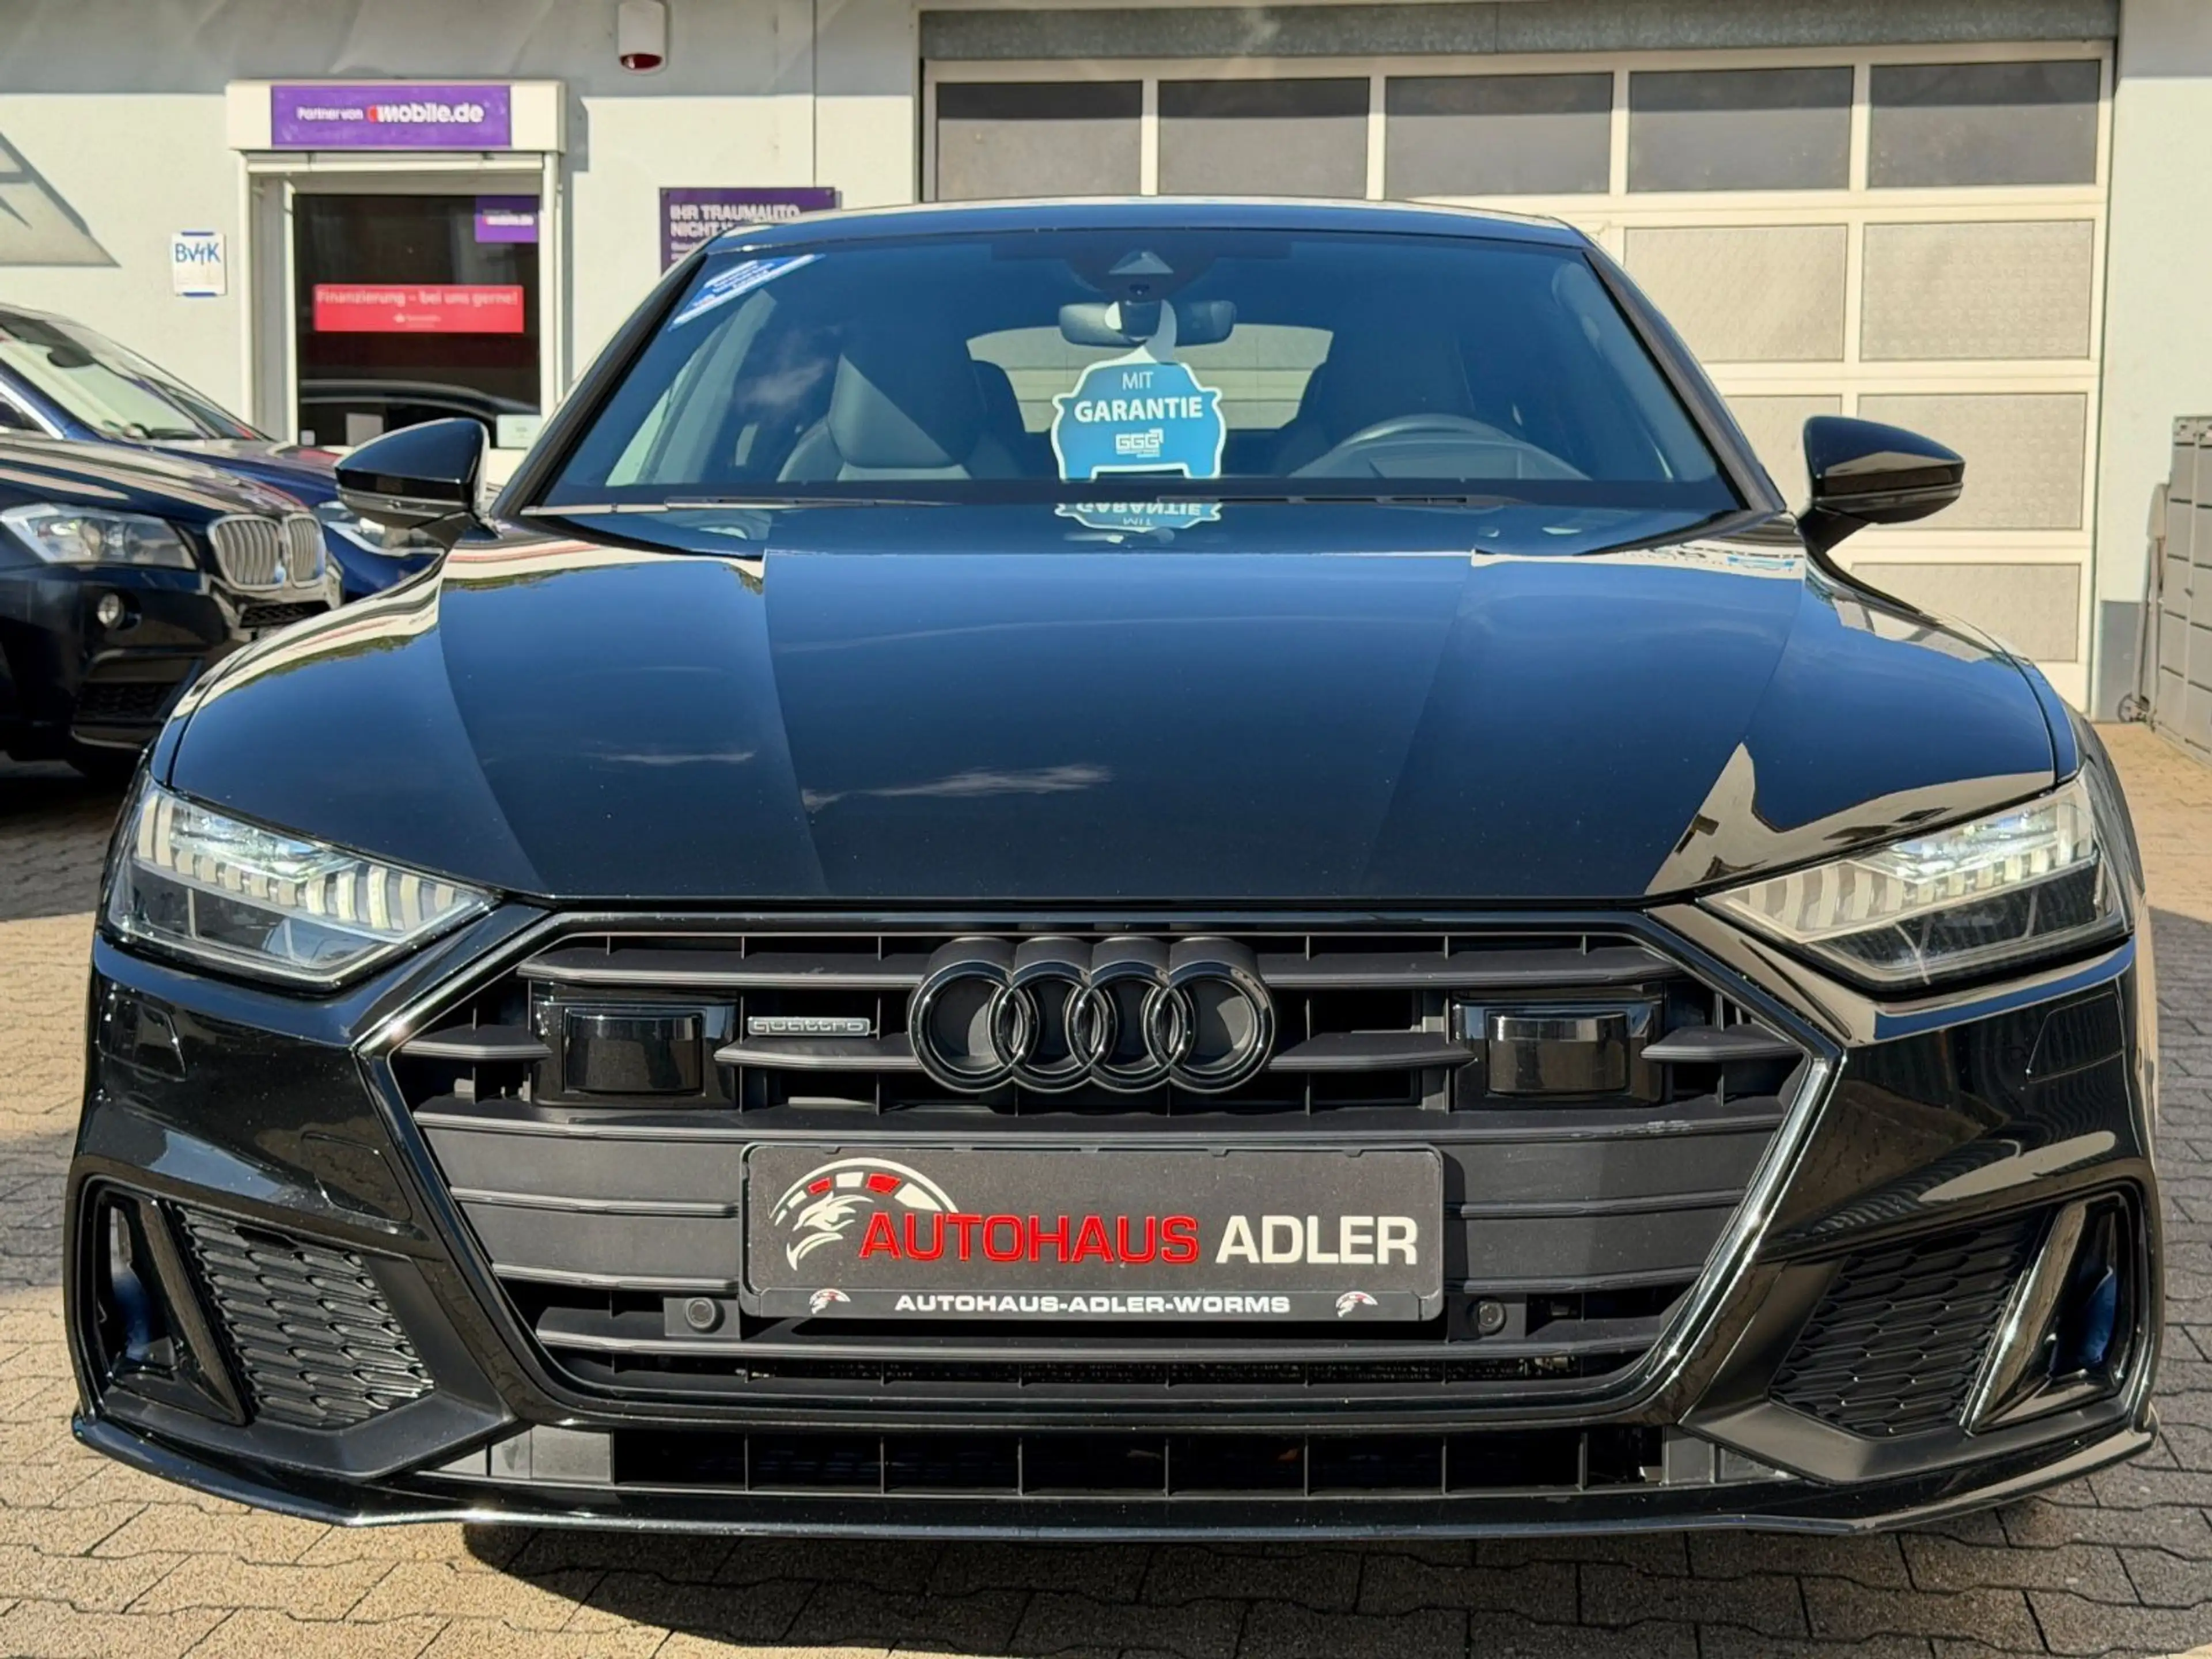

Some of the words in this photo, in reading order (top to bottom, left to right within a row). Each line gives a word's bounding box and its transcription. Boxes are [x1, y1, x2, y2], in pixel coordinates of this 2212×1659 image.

[376, 102, 483, 122] mobile.de
[670, 204, 699, 220] IHR
[700, 204, 801, 223] TRAUMAUTO
[671, 221, 719, 237] NICHT
[317, 290, 406, 308] Finanzierung
[419, 290, 442, 305] bei
[445, 293, 469, 305] uns
[472, 291, 518, 308] gerne!
[1123, 372, 1154, 389] MIT
[1074, 396, 1204, 423] GARANTIE
[753, 1020, 863, 1033] quattro
[859, 1212, 1200, 1264] AUTOHAUS
[1215, 1215, 1418, 1266] ADLER
[895, 1294, 1291, 1315] AUTOHAUS-ADLER-WORMS
